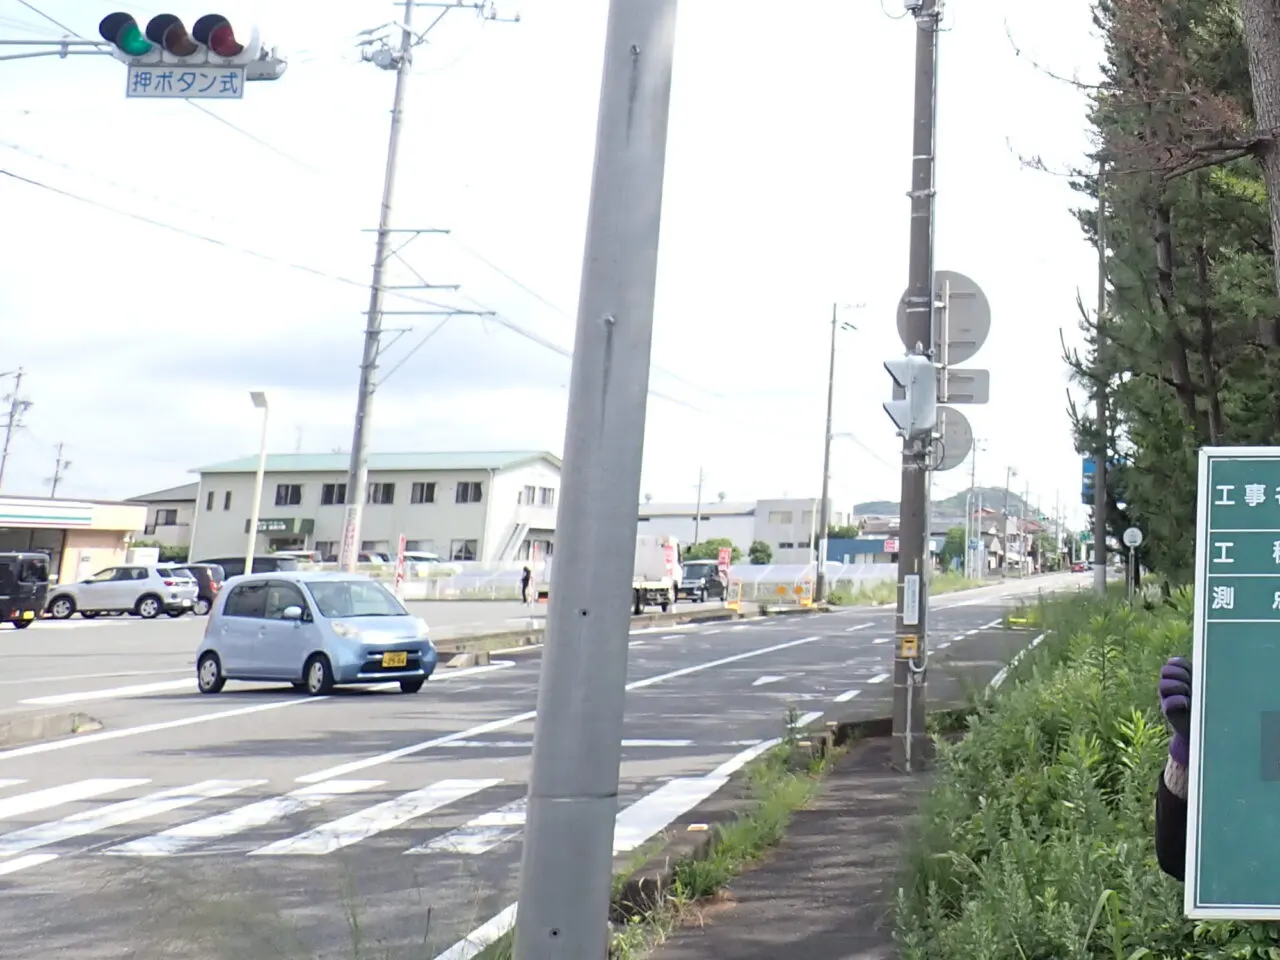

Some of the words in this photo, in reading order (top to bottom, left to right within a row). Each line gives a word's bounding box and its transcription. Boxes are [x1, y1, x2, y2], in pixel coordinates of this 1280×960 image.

[134, 71, 239, 94] 押ボタン式
